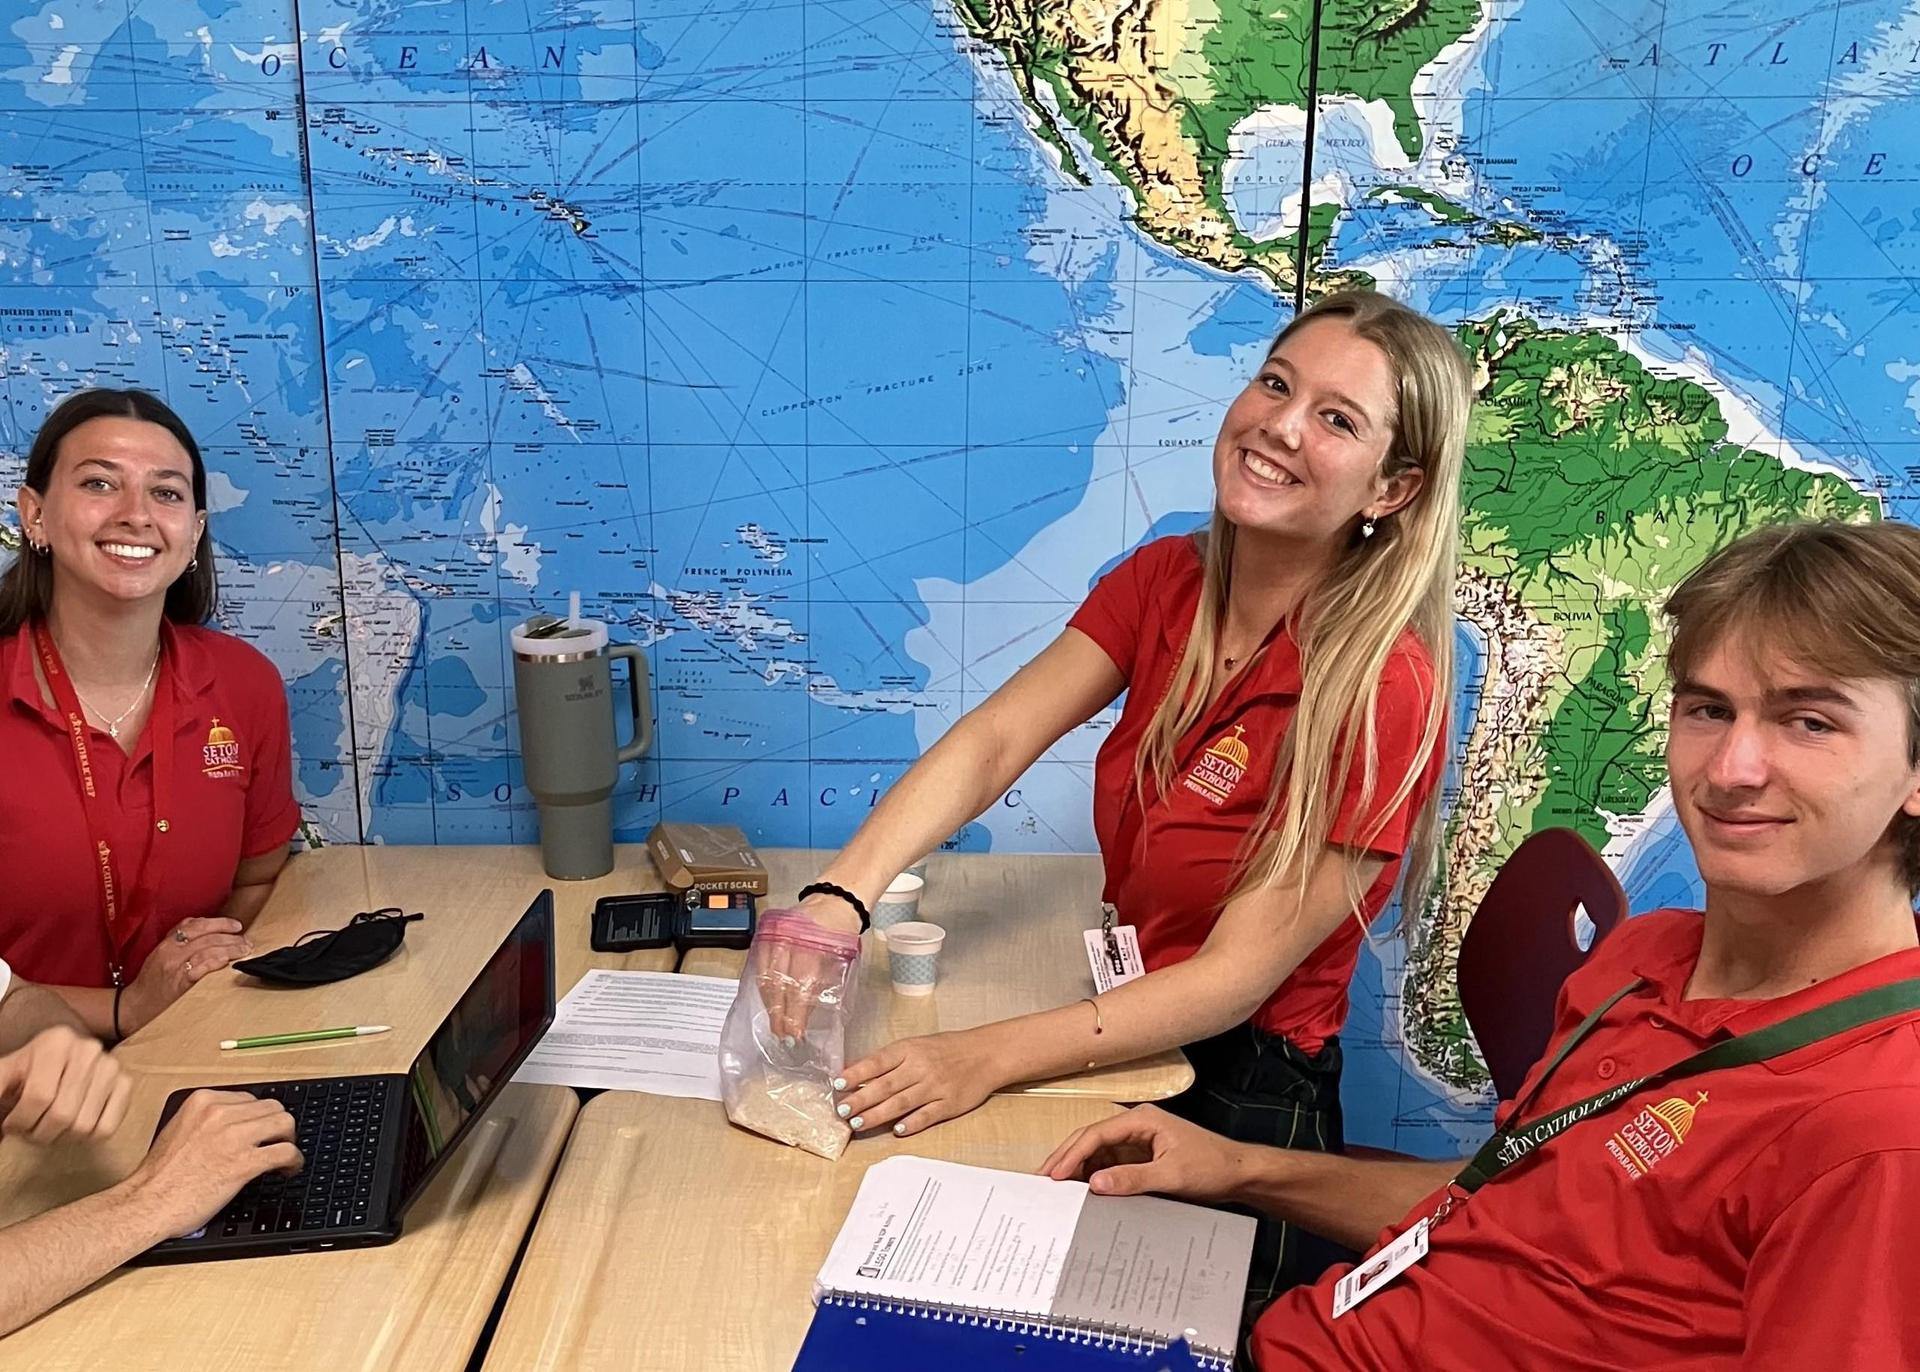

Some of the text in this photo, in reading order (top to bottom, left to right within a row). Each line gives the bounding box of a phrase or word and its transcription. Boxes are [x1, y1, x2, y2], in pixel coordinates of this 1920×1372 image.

[261, 46, 565, 77] OCEAN
[685, 567, 793, 577] FRENCH POLYNESIA
[1553, 612, 1593, 622] BOLIVIA
[1192, 765, 1236, 794] CATHOLIC
[1199, 752, 1246, 784] SETON
[446, 783, 660, 803] SOH
[694, 880, 759, 892] POCKET SCALE
[1496, 1131, 1535, 1167] SETON
[1534, 1096, 1606, 1143] CATHOLIC
[1633, 1109, 1680, 1158] SETON
